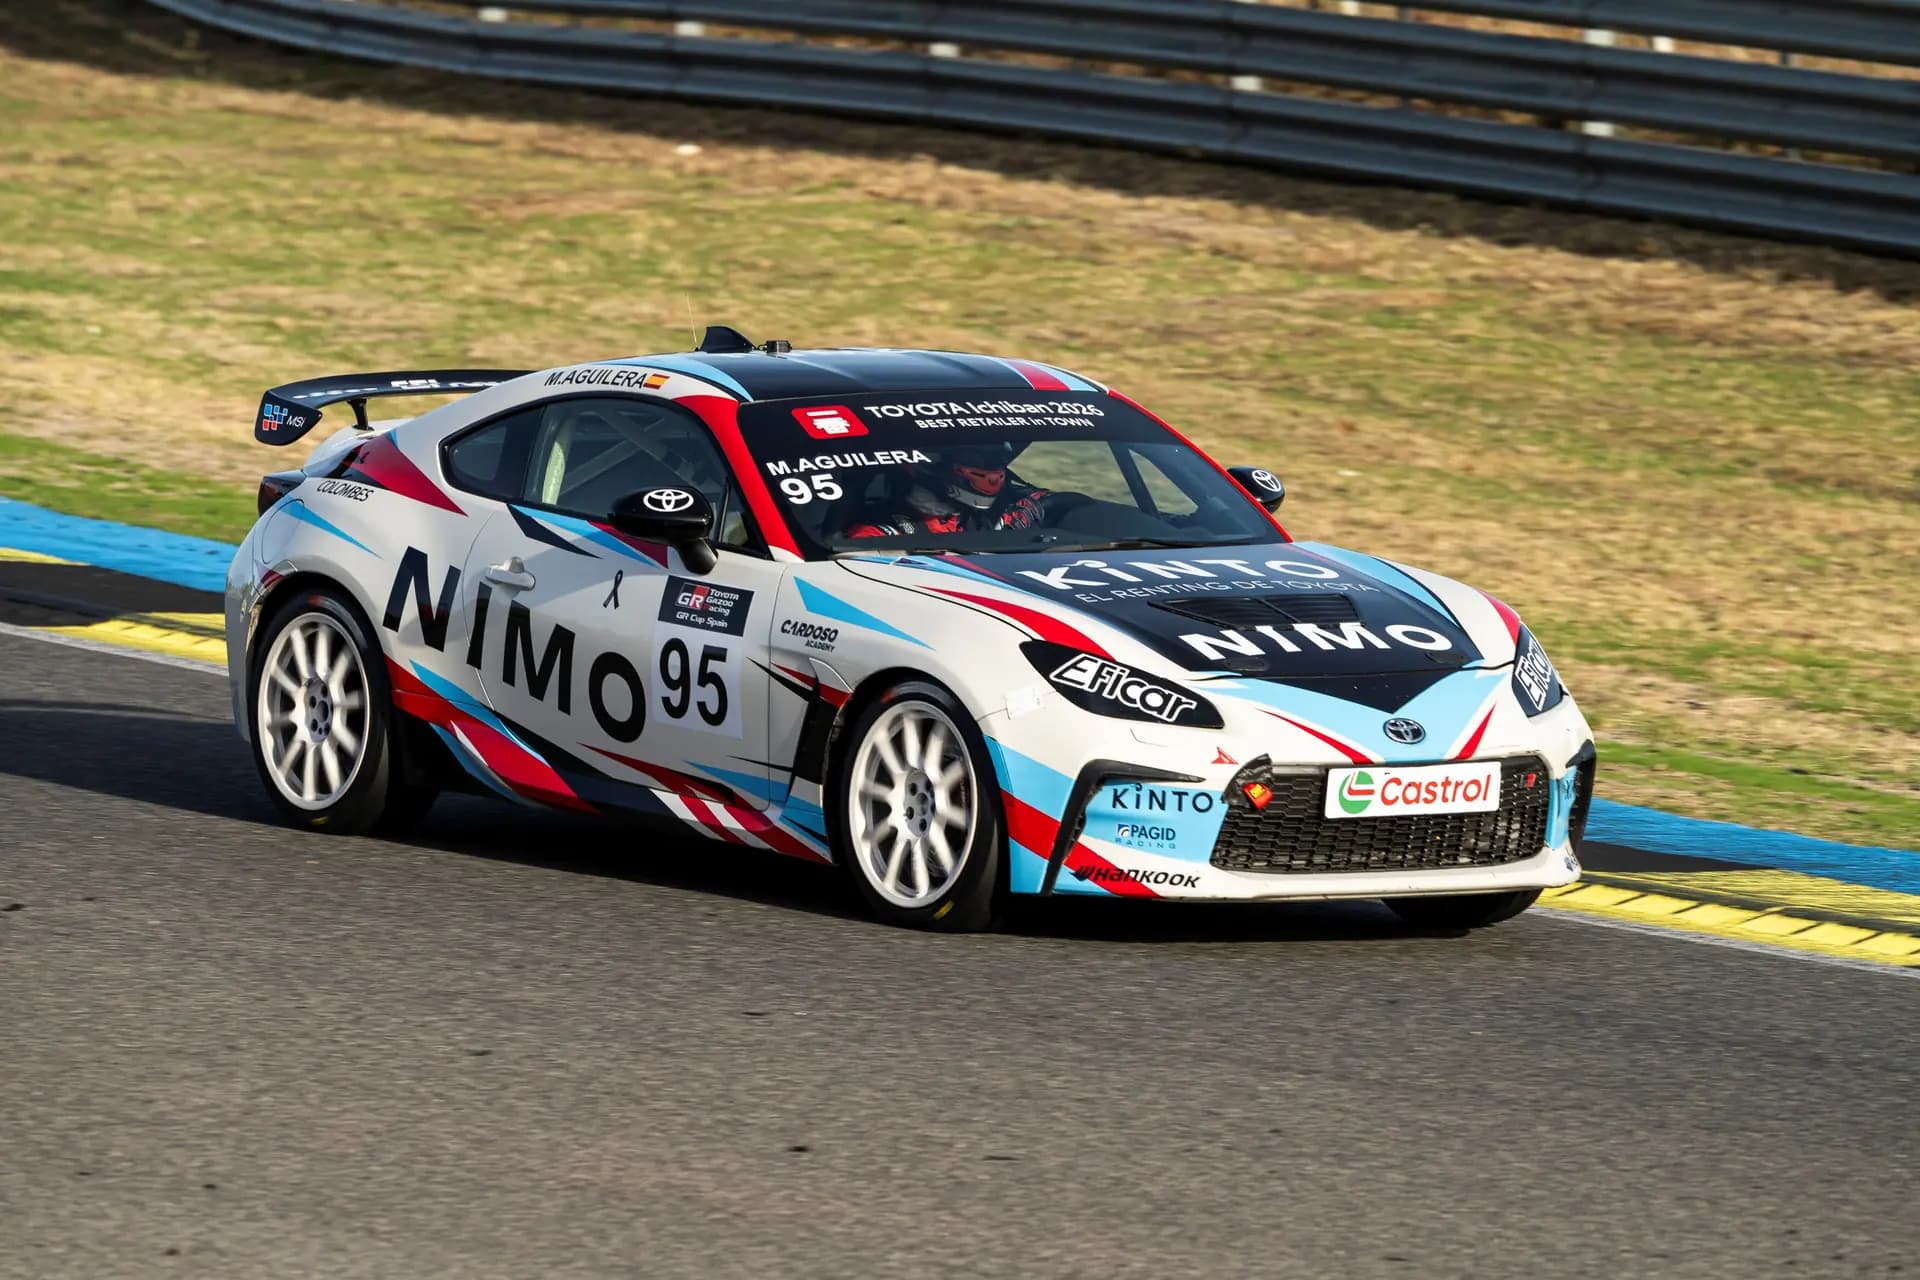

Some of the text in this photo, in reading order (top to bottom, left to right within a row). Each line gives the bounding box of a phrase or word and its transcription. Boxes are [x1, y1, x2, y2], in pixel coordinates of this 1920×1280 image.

[544, 369, 648, 389] M.AGUILERA
[864, 400, 1105, 418] TOYOTA Ichiban 2026
[915, 418, 955, 429] BEST
[957, 417, 1028, 429] RETAILER
[1042, 417, 1096, 427] TOWN
[766, 450, 932, 476] M.AGUILERA
[317, 480, 374, 502] COLOMBES
[780, 473, 843, 505] 95
[678, 592, 704, 609] GR
[1075, 580, 1381, 603] EL RENTING DE TOYOTA
[676, 611, 728, 628] GR Cup Spain
[382, 545, 647, 744] NIMO
[805, 640, 836, 652] ACADEMY
[1178, 622, 1453, 661] NIMO
[659, 637, 728, 727] 95
[1380, 773, 1492, 806] Castrol
[1115, 837, 1177, 849] RACING
[1130, 824, 1176, 841] PAGID
